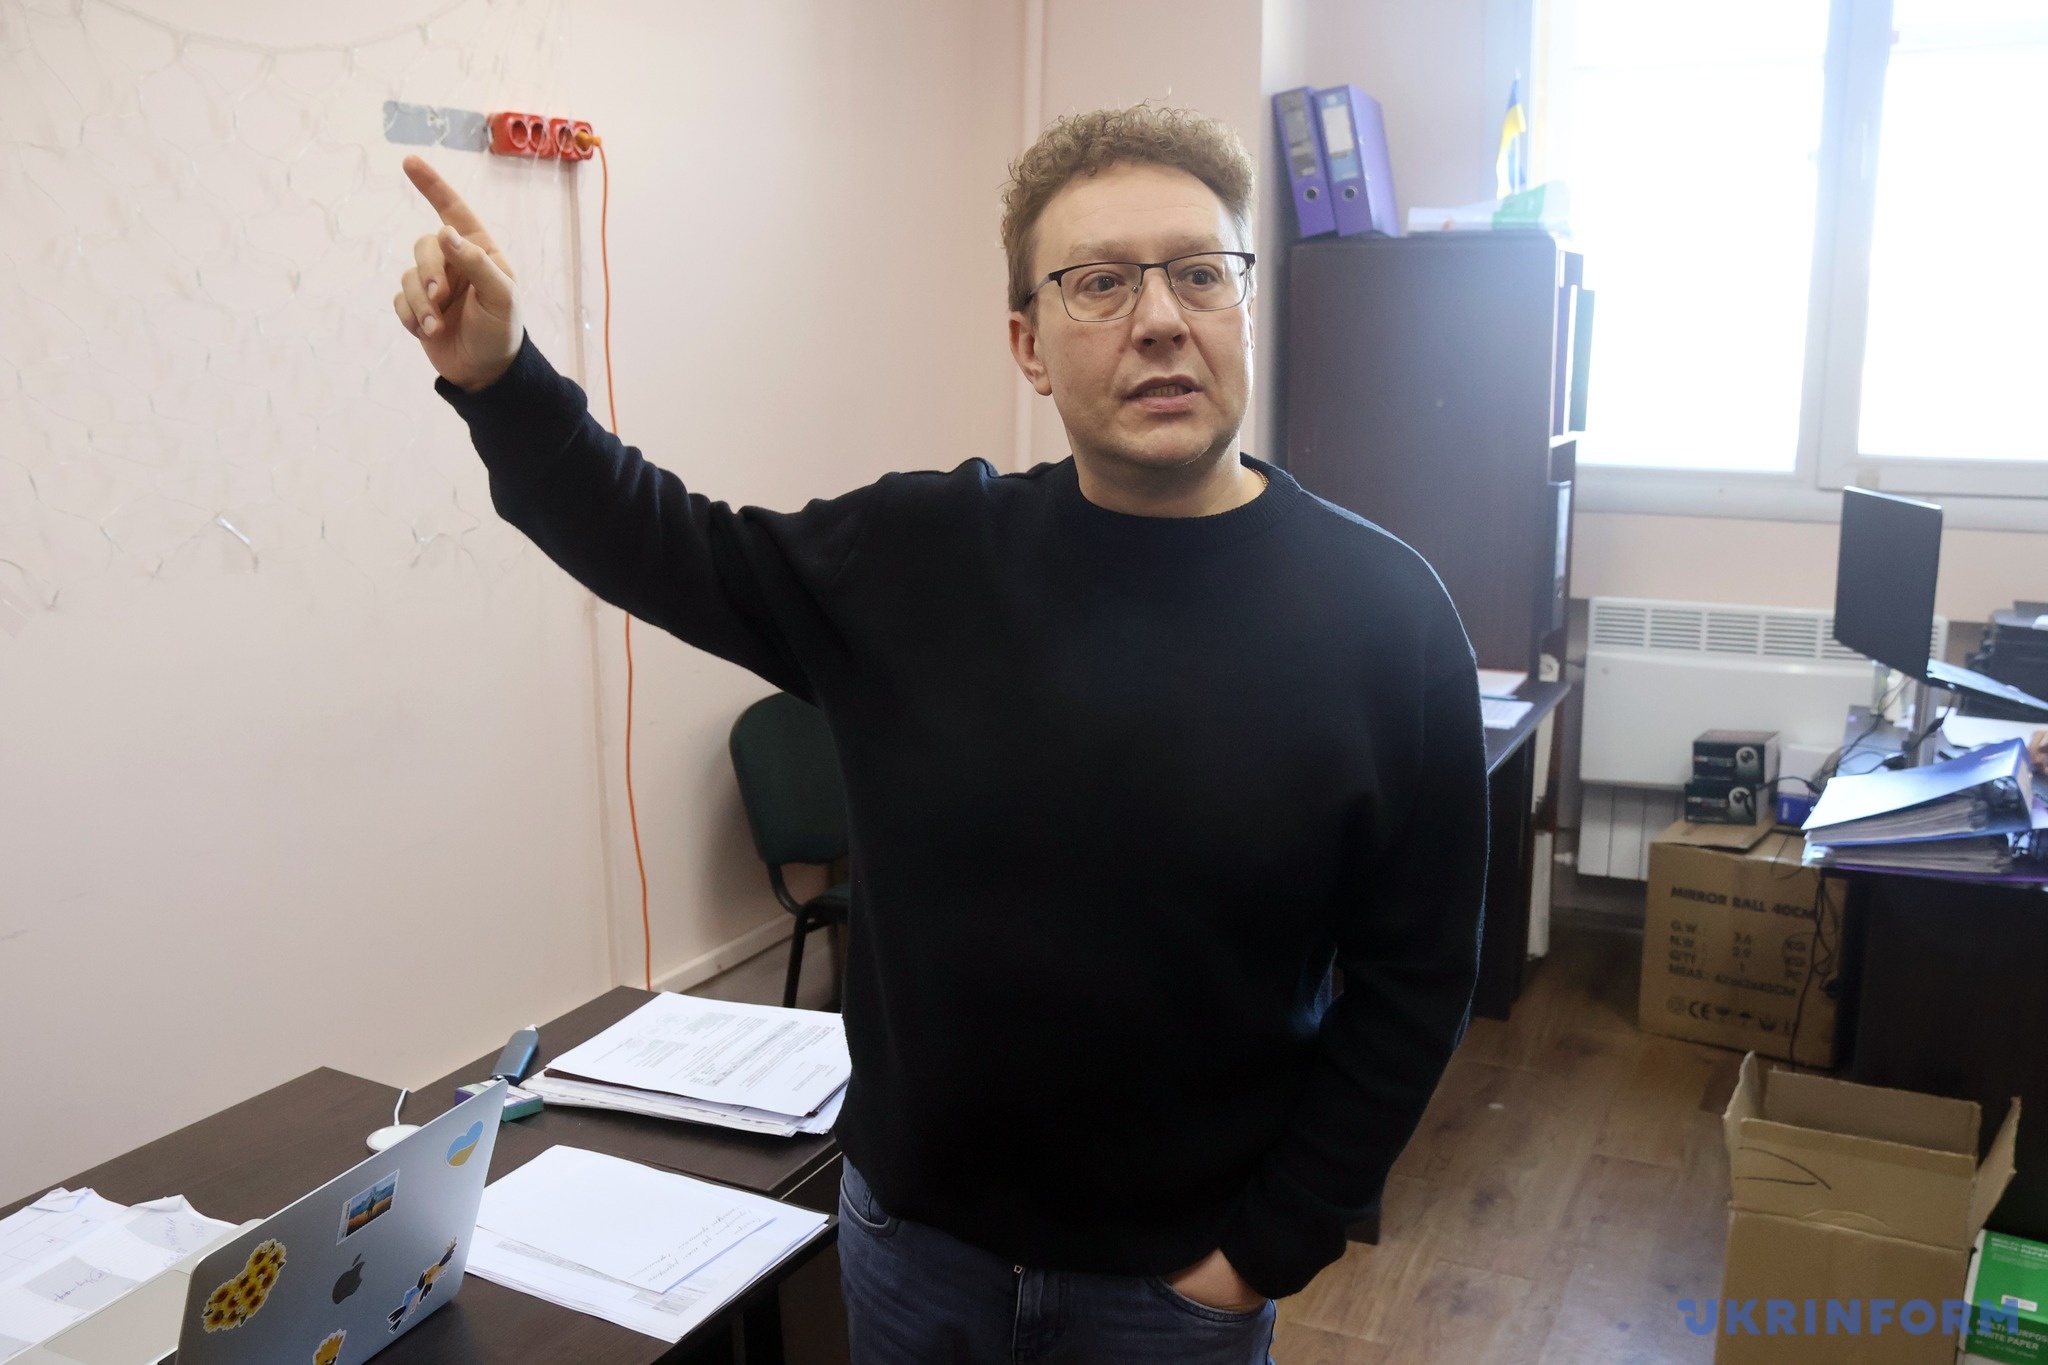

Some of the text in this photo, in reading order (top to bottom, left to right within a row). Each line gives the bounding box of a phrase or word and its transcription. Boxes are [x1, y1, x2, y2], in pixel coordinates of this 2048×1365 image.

[1672, 887, 1727, 905] MIRROR
[1733, 897, 1766, 912] BALL
[2007, 1336, 2039, 1350] PAPER
